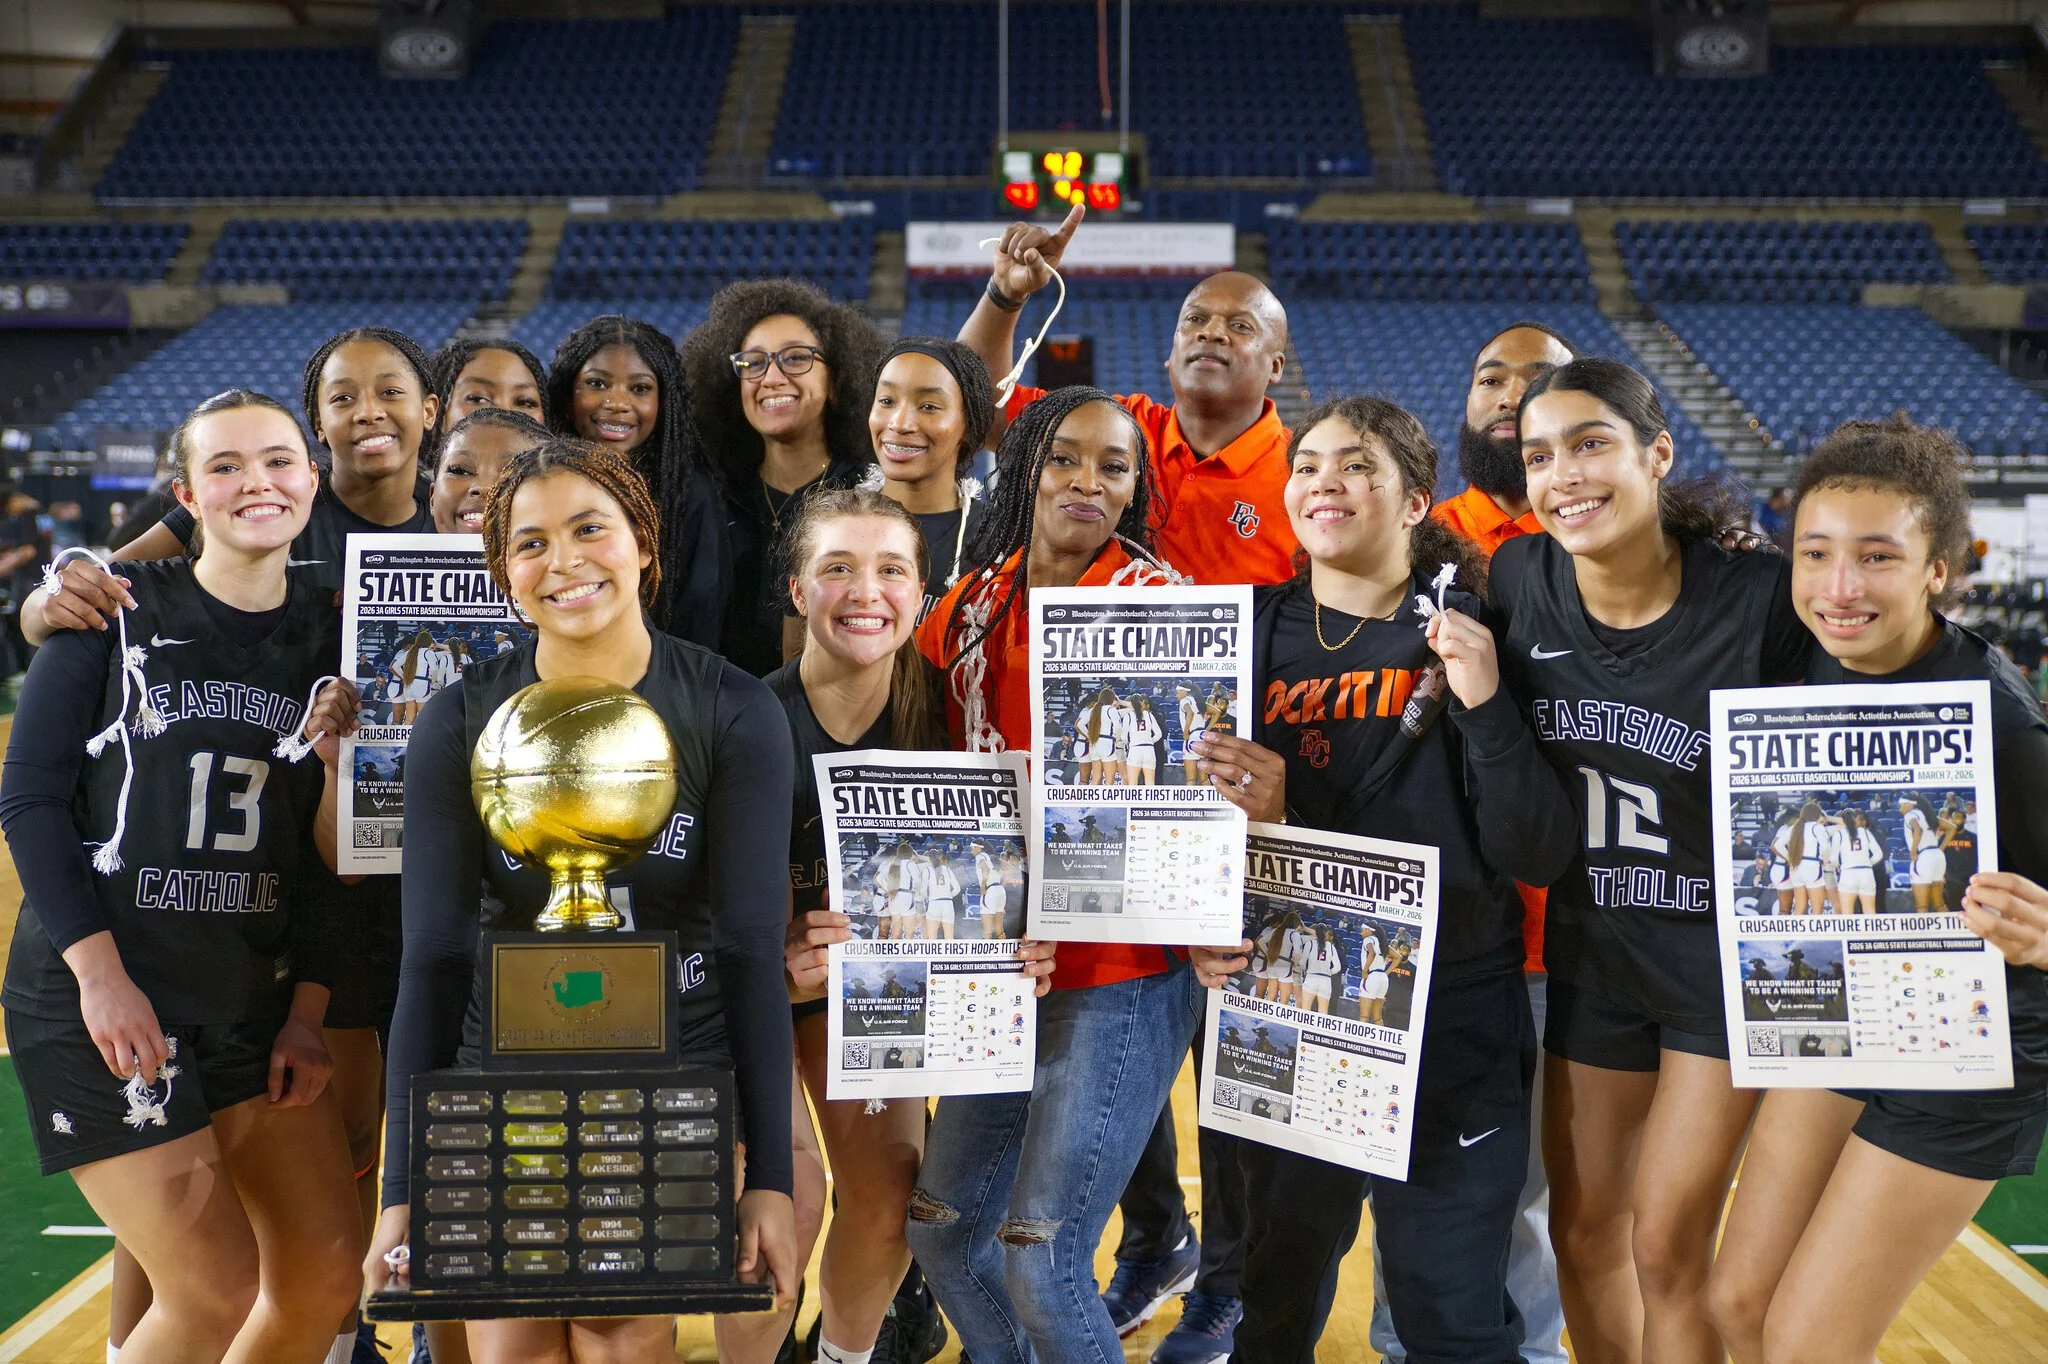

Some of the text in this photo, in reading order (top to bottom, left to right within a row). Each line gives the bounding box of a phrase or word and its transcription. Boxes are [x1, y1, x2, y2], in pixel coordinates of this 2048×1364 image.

[359, 572, 434, 602] STATE
[385, 607, 400, 615] GIRLS
[402, 607, 419, 615] STATE
[421, 607, 455, 615] BASKETBALL
[1043, 626, 1237, 658] STATE CHAMPS!
[1045, 662, 1186, 672] 2026 3A GIRLS STATE BASKETBALL CHAMPIONSHIPS
[1215, 663, 1220, 671] 7,
[1265, 678, 1334, 724] OCK
[1334, 671, 1375, 719] IT
[148, 681, 301, 737] EASTSID
[1764, 711, 1935, 723] Washington Interscholastic Activities Association
[1137, 720, 1146, 731] 13
[1533, 700, 1711, 771] EASTSIDE
[1729, 729, 1972, 769] STATE CHAMPS!
[859, 771, 891, 779] Washington
[1732, 771, 1910, 785] 2026 3A GIRLS STATE BASKETBALL CHAMPIONSHIPS
[1918, 770, 1973, 780] MARCH 7, 2026
[186, 751, 270, 852] 13
[833, 786, 1020, 818] STATE CHAMPS!
[1048, 789, 1227, 801] CRUSADERS CAPTURE FIRST HOOPS TIT
[1577, 766, 1669, 855] 12
[839, 819, 853, 827] 2026
[854, 819, 862, 827] 3A
[863, 819, 878, 827] GIRLS
[897, 820, 931, 828] BASKETBALL
[932, 820, 977, 829] CHAMPIONSHIPS
[1257, 840, 1395, 867] Washington Interscholastic Activities Association
[936, 872, 945, 886] 13
[1247, 852, 1423, 907] TATE CHAMPS!
[136, 867, 279, 913] CATHOLIC
[1249, 880, 1373, 911] 3A GIRLS STATE BASKETBALL CHAMPIONSHIPS
[1588, 866, 1709, 911] THOLIC
[1379, 905, 1422, 920] MARCH 7, 2026
[1740, 917, 1967, 933] CRUSADERS CAPTURE FIRST HOOPS TIT
[845, 943, 899, 955] CRUSADERS
[902, 942, 942, 955] CAPTURE
[945, 942, 969, 954] FIRST
[971, 942, 999, 954] HOOPS
[1317, 951, 1326, 961] 13
[1224, 994, 1402, 1045] CRUSADERS CAPTURE FIRST HOOPS TITLE
[587, 1164, 635, 1173] LAKESIDE
[587, 1195, 636, 1206] PRAIRIE
[587, 1230, 635, 1238] LAKESIDE
[588, 1261, 635, 1270] BLANCHET
